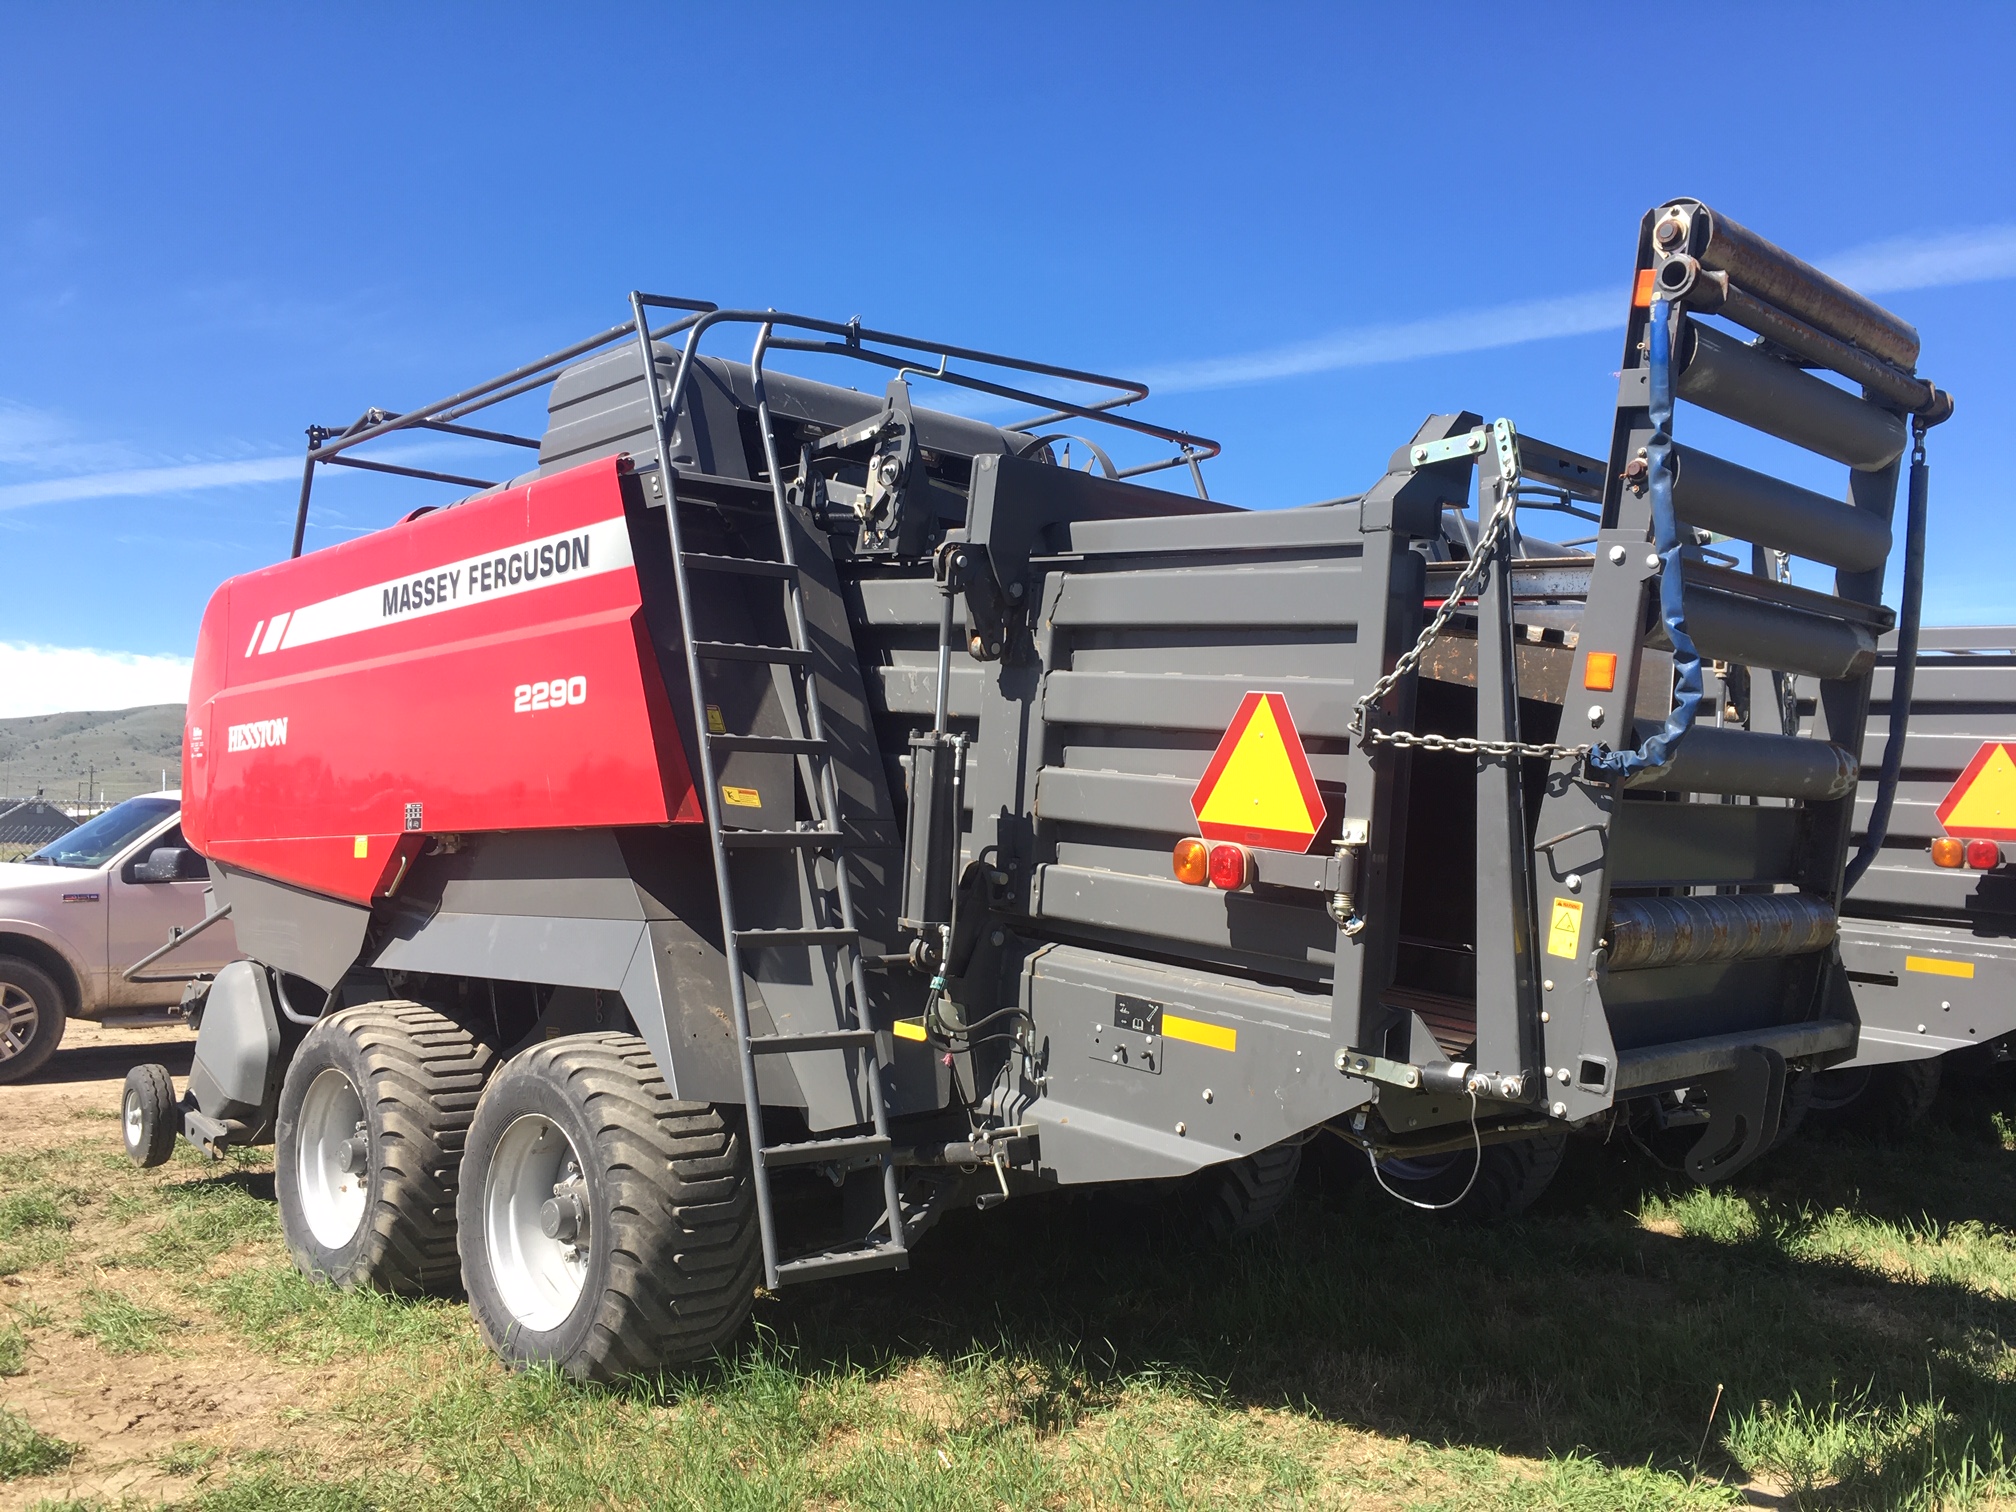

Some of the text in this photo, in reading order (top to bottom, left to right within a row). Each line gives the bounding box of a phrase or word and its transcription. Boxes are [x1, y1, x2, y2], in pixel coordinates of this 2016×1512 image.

[382, 534, 590, 617] MASSEY FERGUSON
[514, 675, 587, 713] 2290
[228, 717, 288, 752] HESSTON
